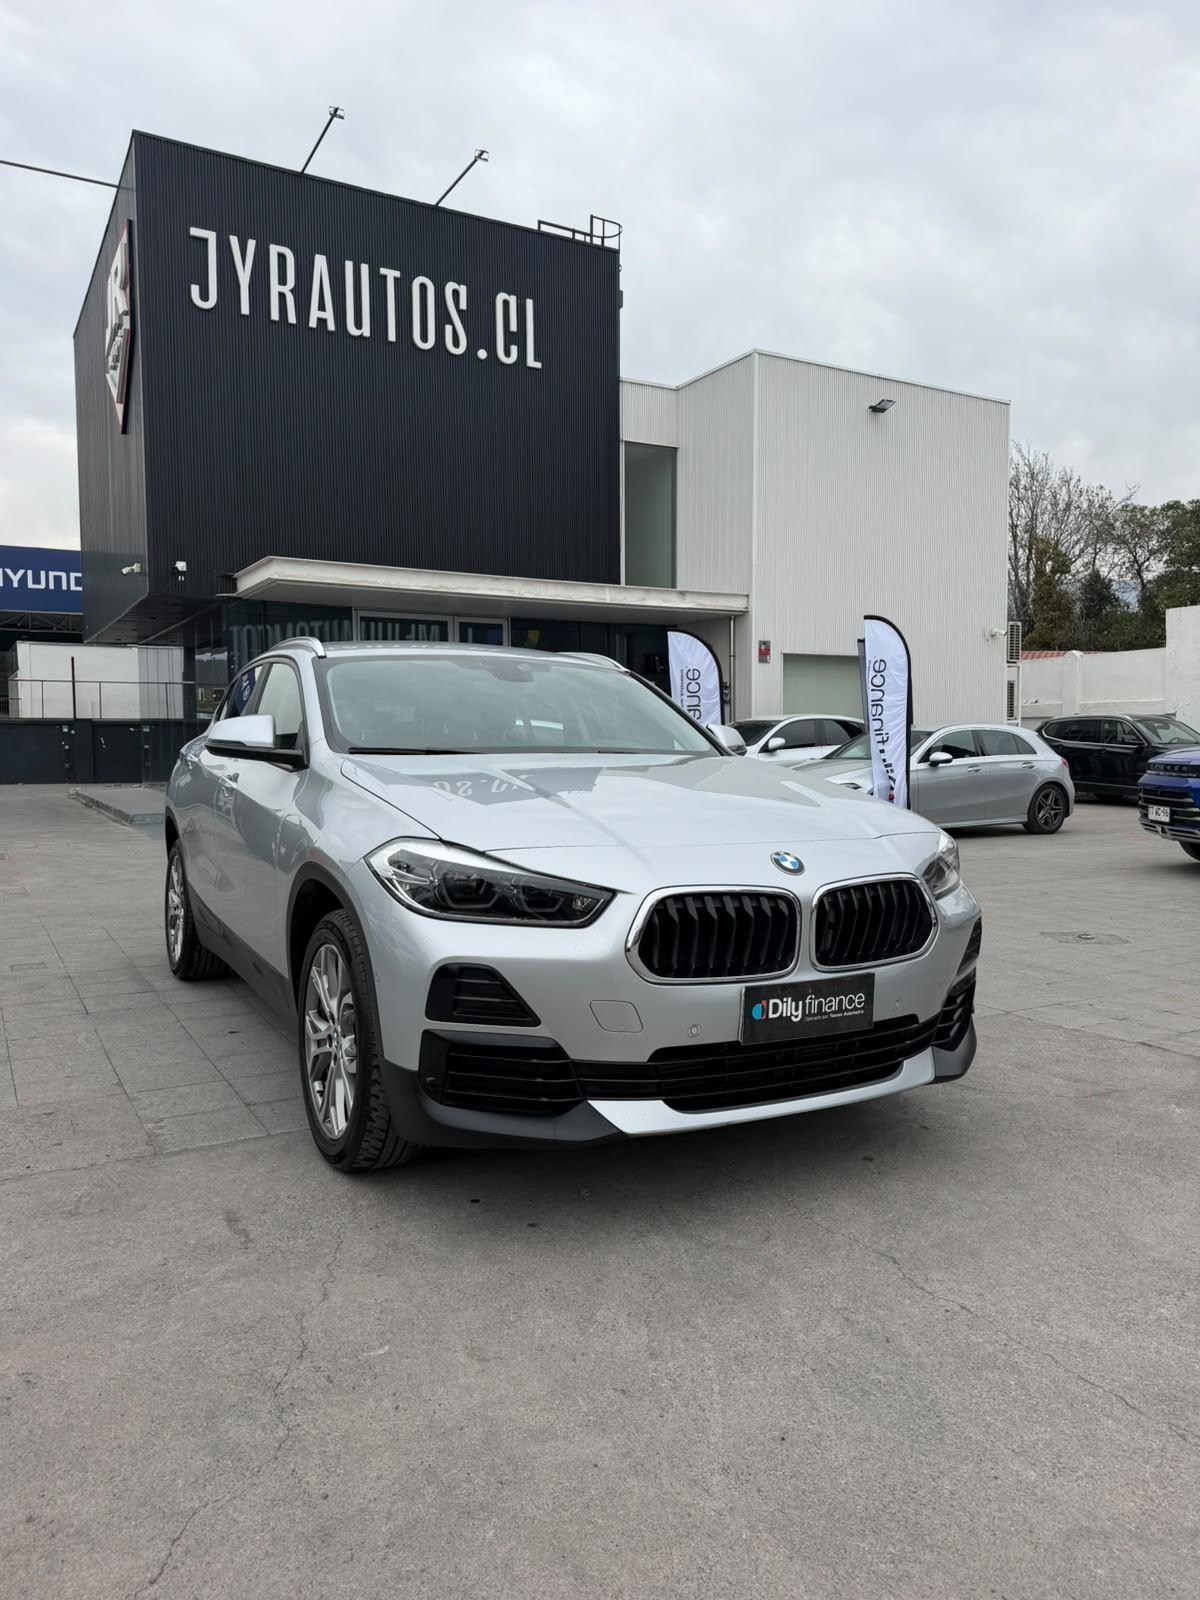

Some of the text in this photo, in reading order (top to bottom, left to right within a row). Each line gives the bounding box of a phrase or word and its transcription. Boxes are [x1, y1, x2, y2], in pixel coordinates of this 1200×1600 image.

[189, 226, 542, 369] JYRAUTOS.CL
[0, 567, 83, 592] YUND
[767, 992, 865, 1022] Dily finance
